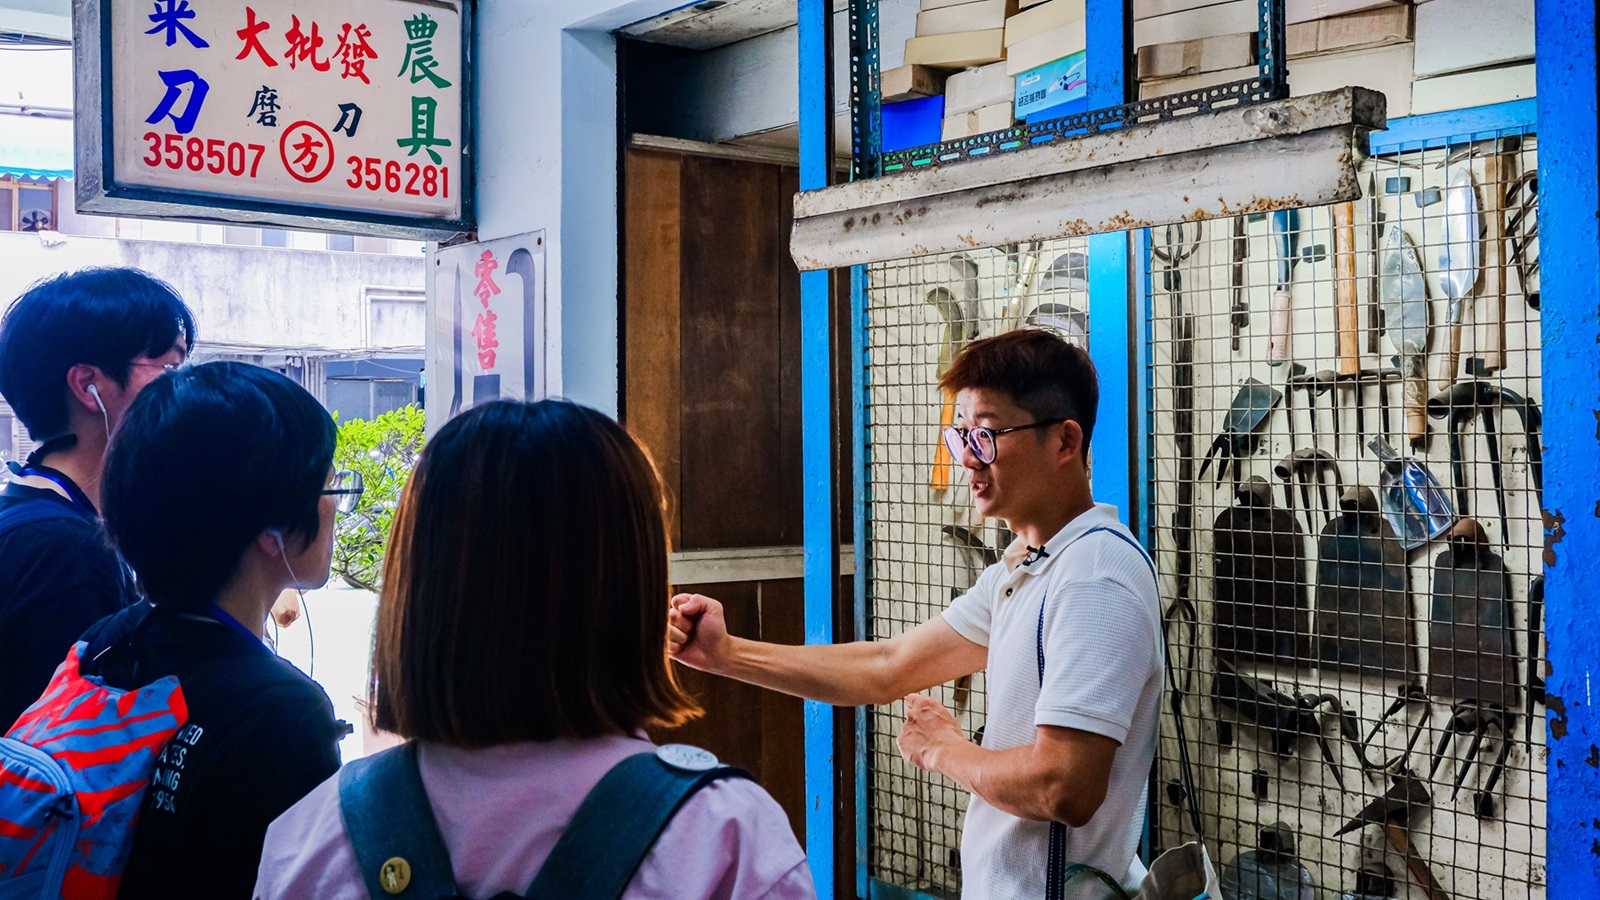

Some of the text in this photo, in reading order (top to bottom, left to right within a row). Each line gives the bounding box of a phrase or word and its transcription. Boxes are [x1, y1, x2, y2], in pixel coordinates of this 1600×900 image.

[236, 7, 378, 84] 大批發
[397, 13, 452, 165] 農具
[143, 132, 265, 178] 358507
[346, 156, 449, 198] 356281
[471, 249, 501, 370] 零售
